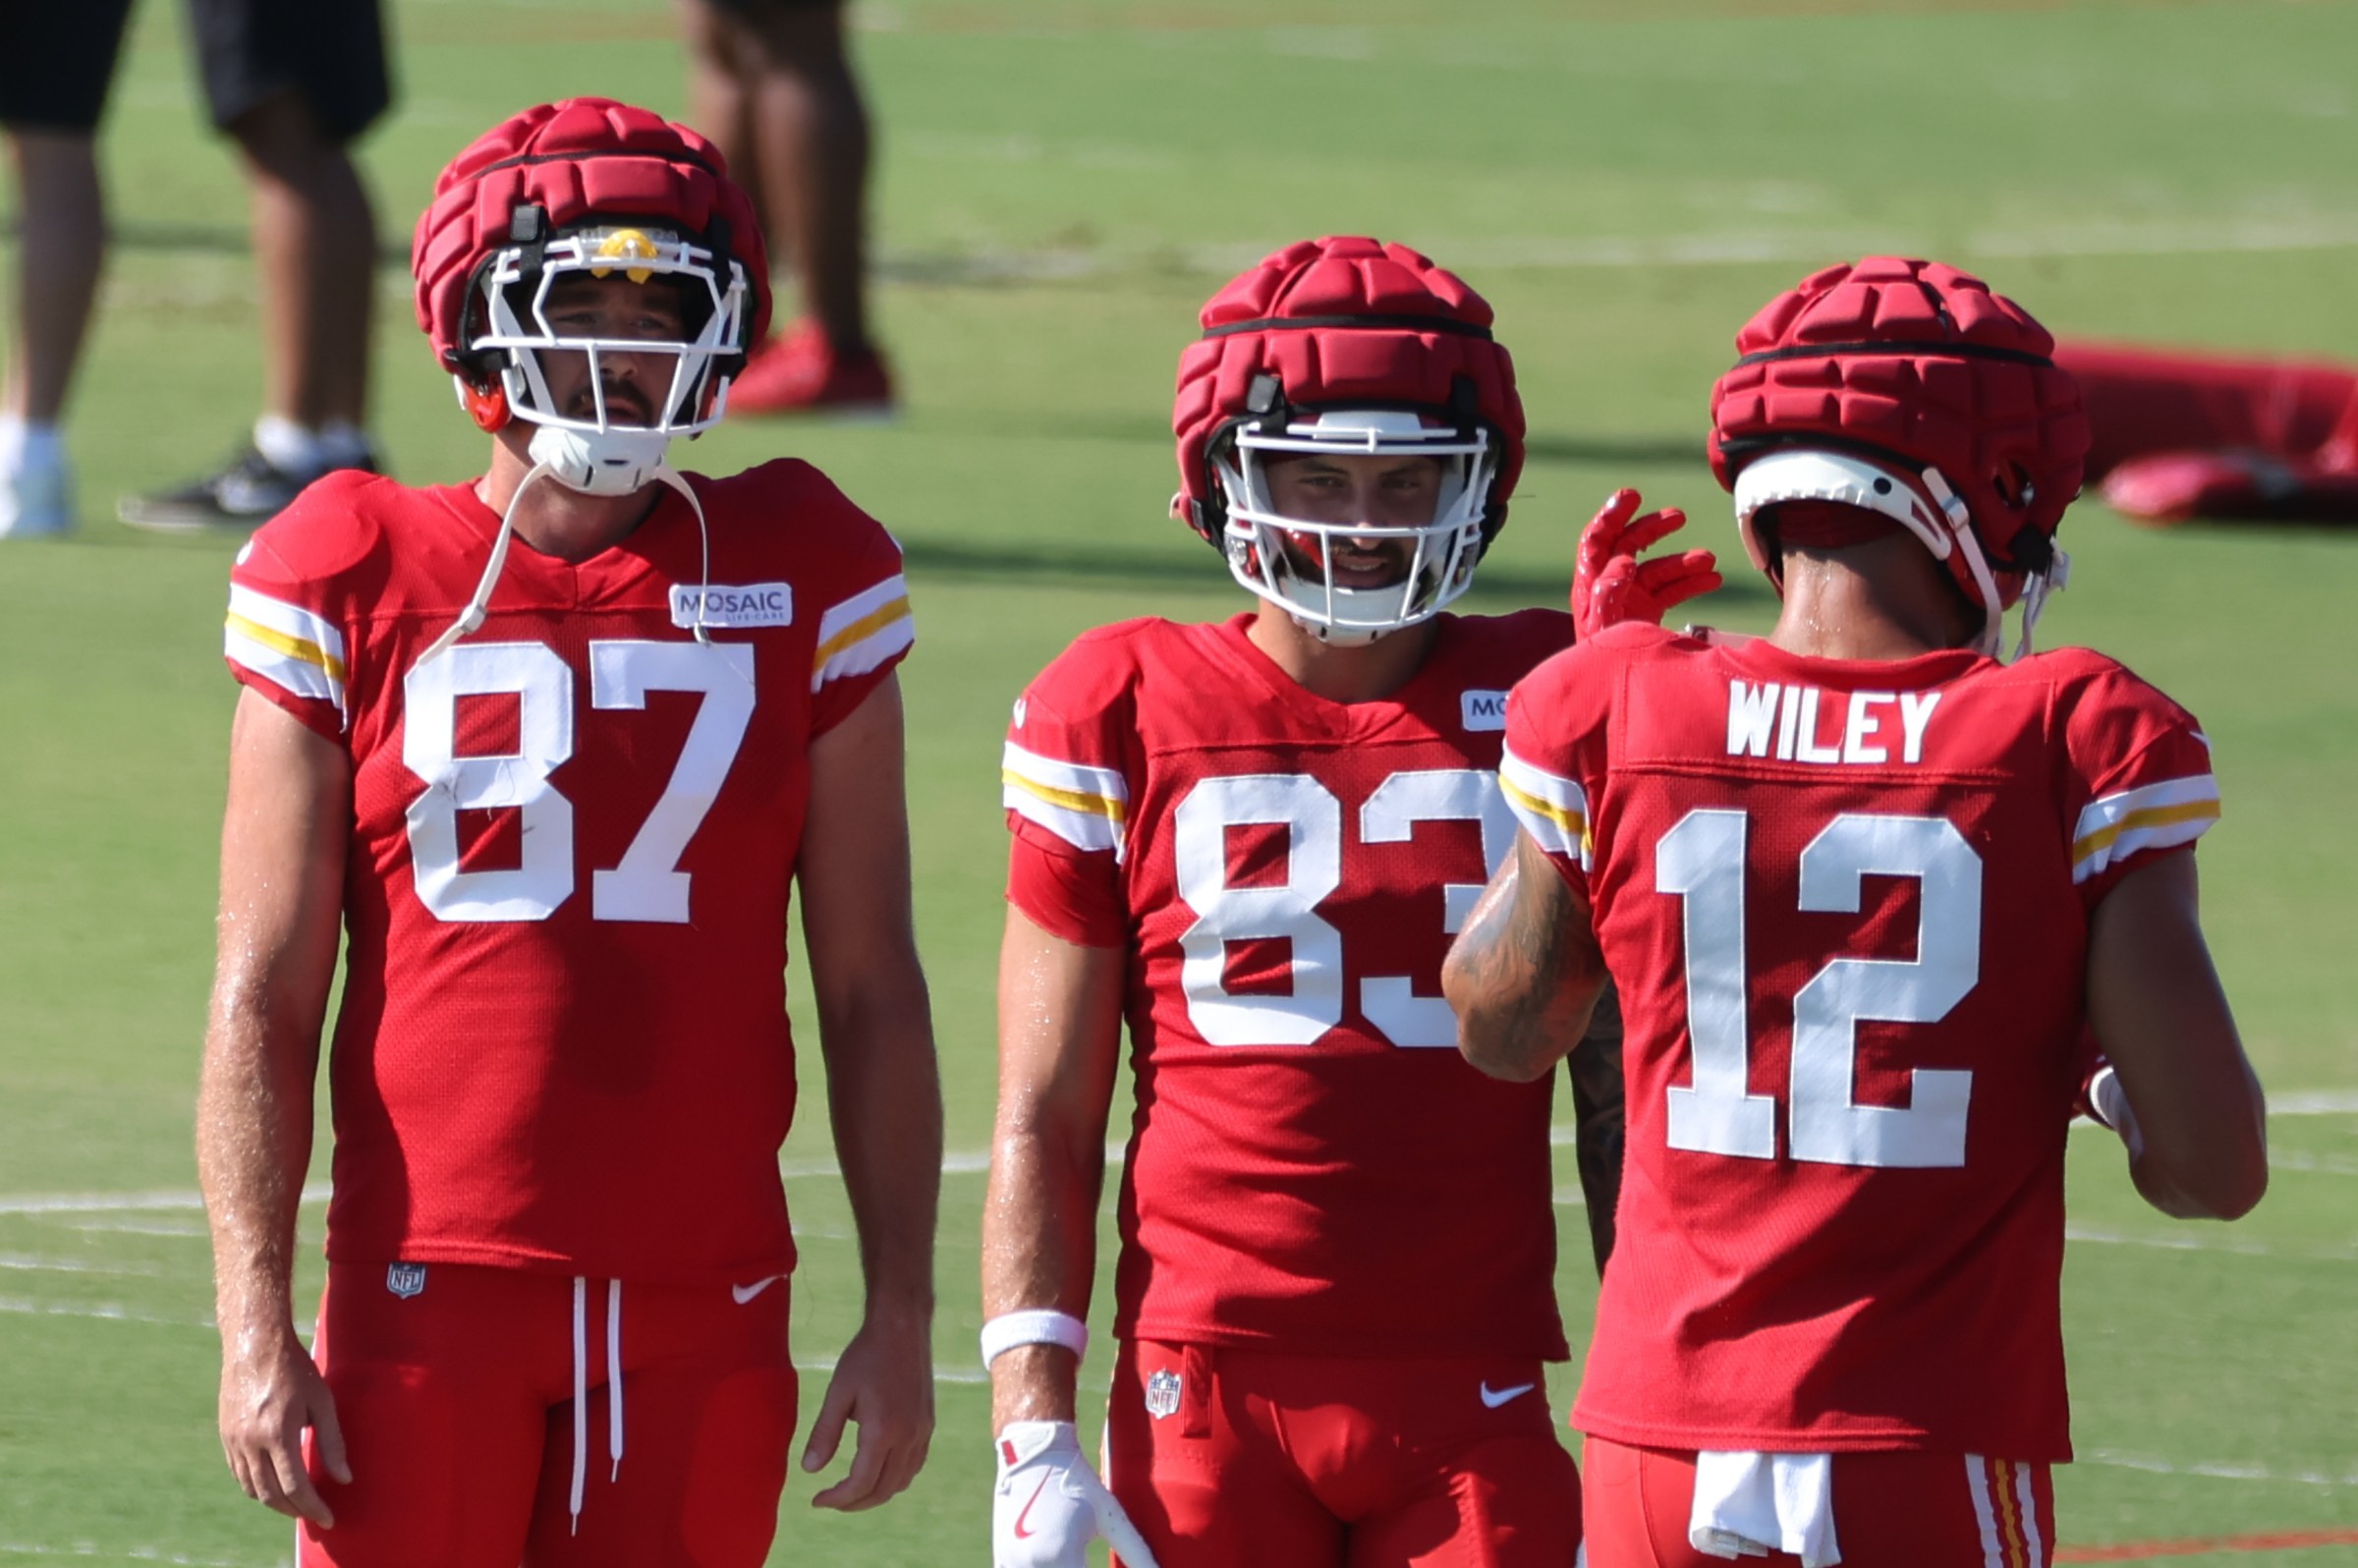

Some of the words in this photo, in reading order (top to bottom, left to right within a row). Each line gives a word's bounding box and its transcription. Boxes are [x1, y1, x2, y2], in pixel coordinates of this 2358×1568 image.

[680, 591, 783, 612] MOSAIC
[1727, 680, 1941, 763] WILEY
[403, 640, 756, 923] 87
[1175, 769, 1522, 1047] 83
[1656, 810, 1983, 1167] 12
[393, 1270, 419, 1289] NFL
[1151, 1389, 1175, 1409] NFL
